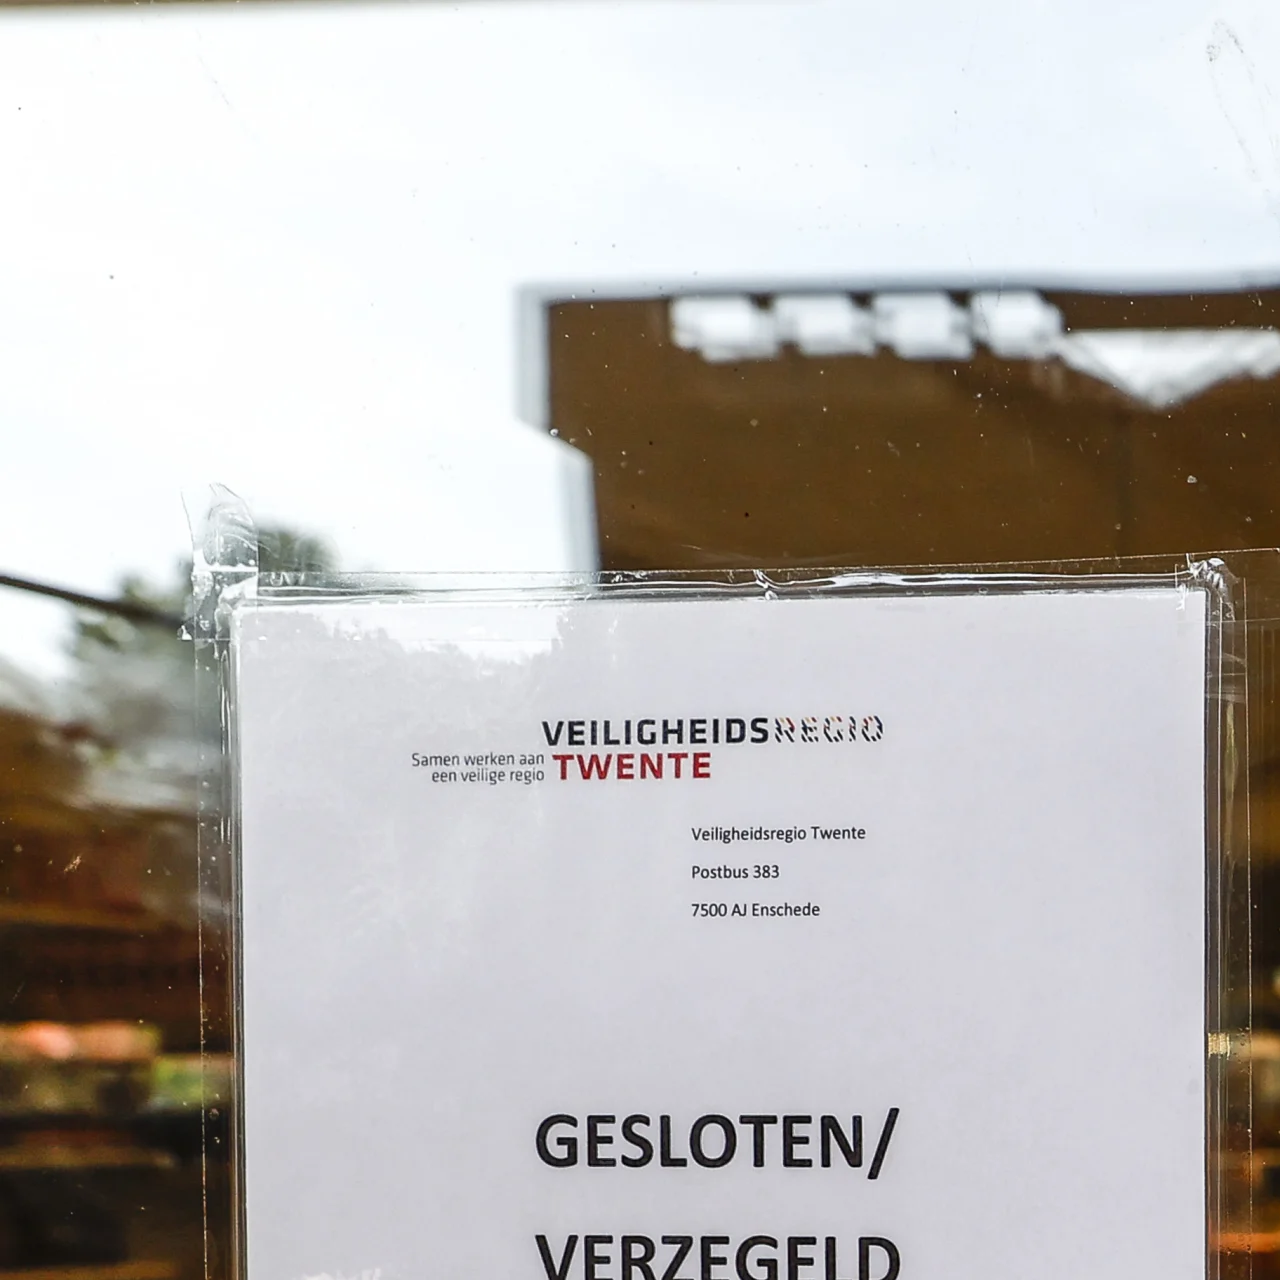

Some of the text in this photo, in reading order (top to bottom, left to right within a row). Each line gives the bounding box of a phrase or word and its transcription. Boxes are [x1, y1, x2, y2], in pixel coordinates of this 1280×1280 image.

[412, 752, 544, 766] Samen werken aan
[552, 752, 712, 781] TWENTE
[432, 768, 544, 785] een veilige regio
[692, 826, 865, 844] Veiligheidsregio Twente
[692, 865, 779, 879] Postbus 383
[692, 902, 820, 917] 7500 AJ Enschede
[536, 1108, 900, 1180] GESLOTEN/
